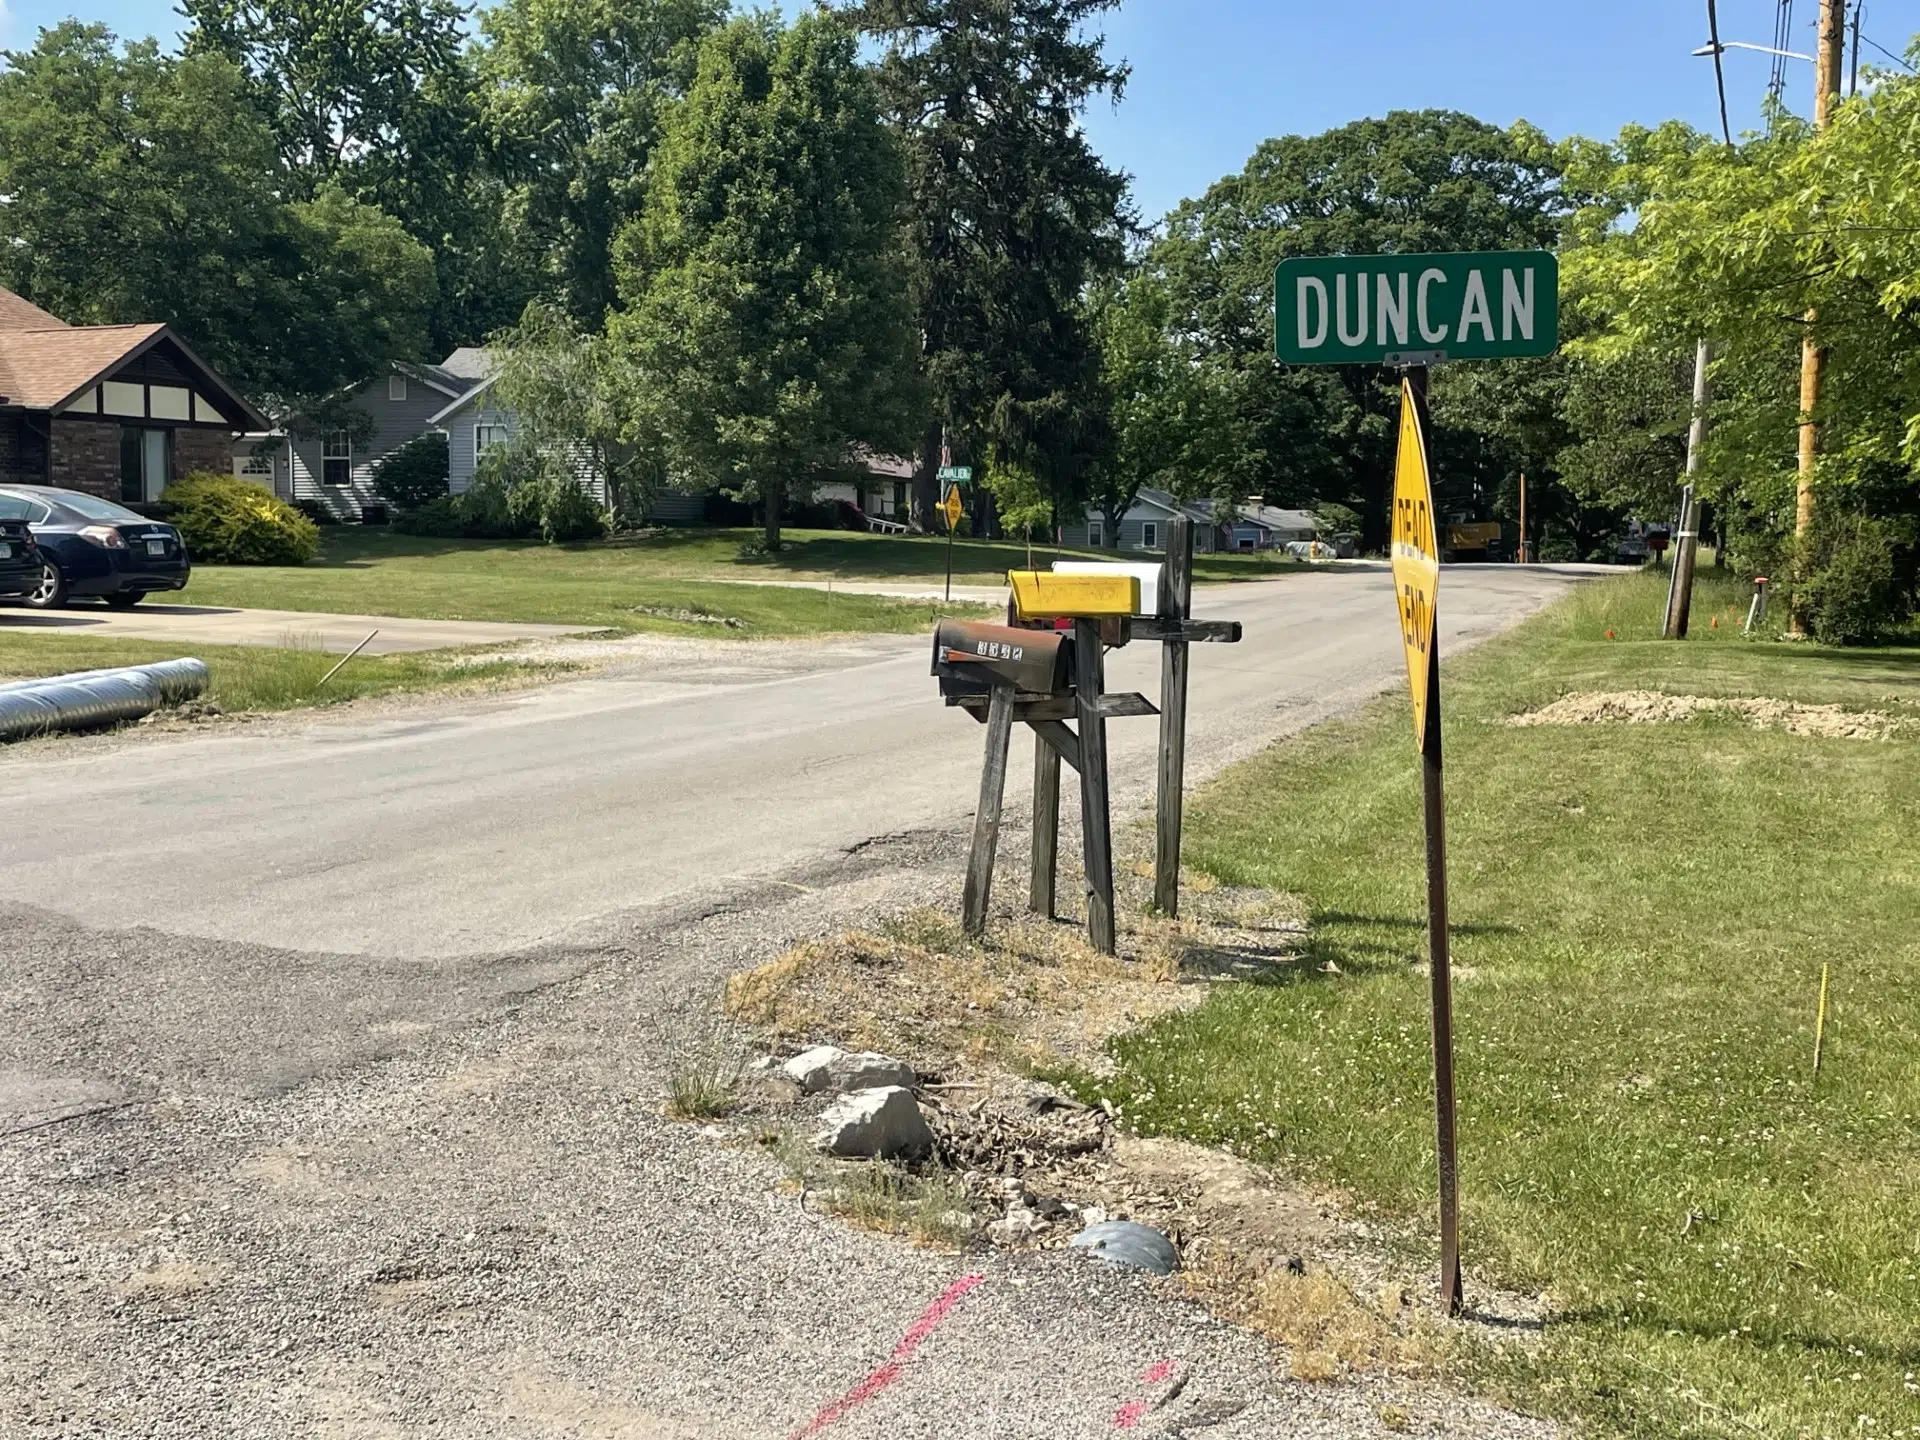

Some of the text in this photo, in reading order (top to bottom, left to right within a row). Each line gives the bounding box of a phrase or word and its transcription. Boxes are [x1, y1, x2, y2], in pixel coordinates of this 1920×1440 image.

[1297, 268, 1534, 348] DUNCAN
[1398, 498, 1426, 560] DEAD
[1405, 584, 1425, 654] END
